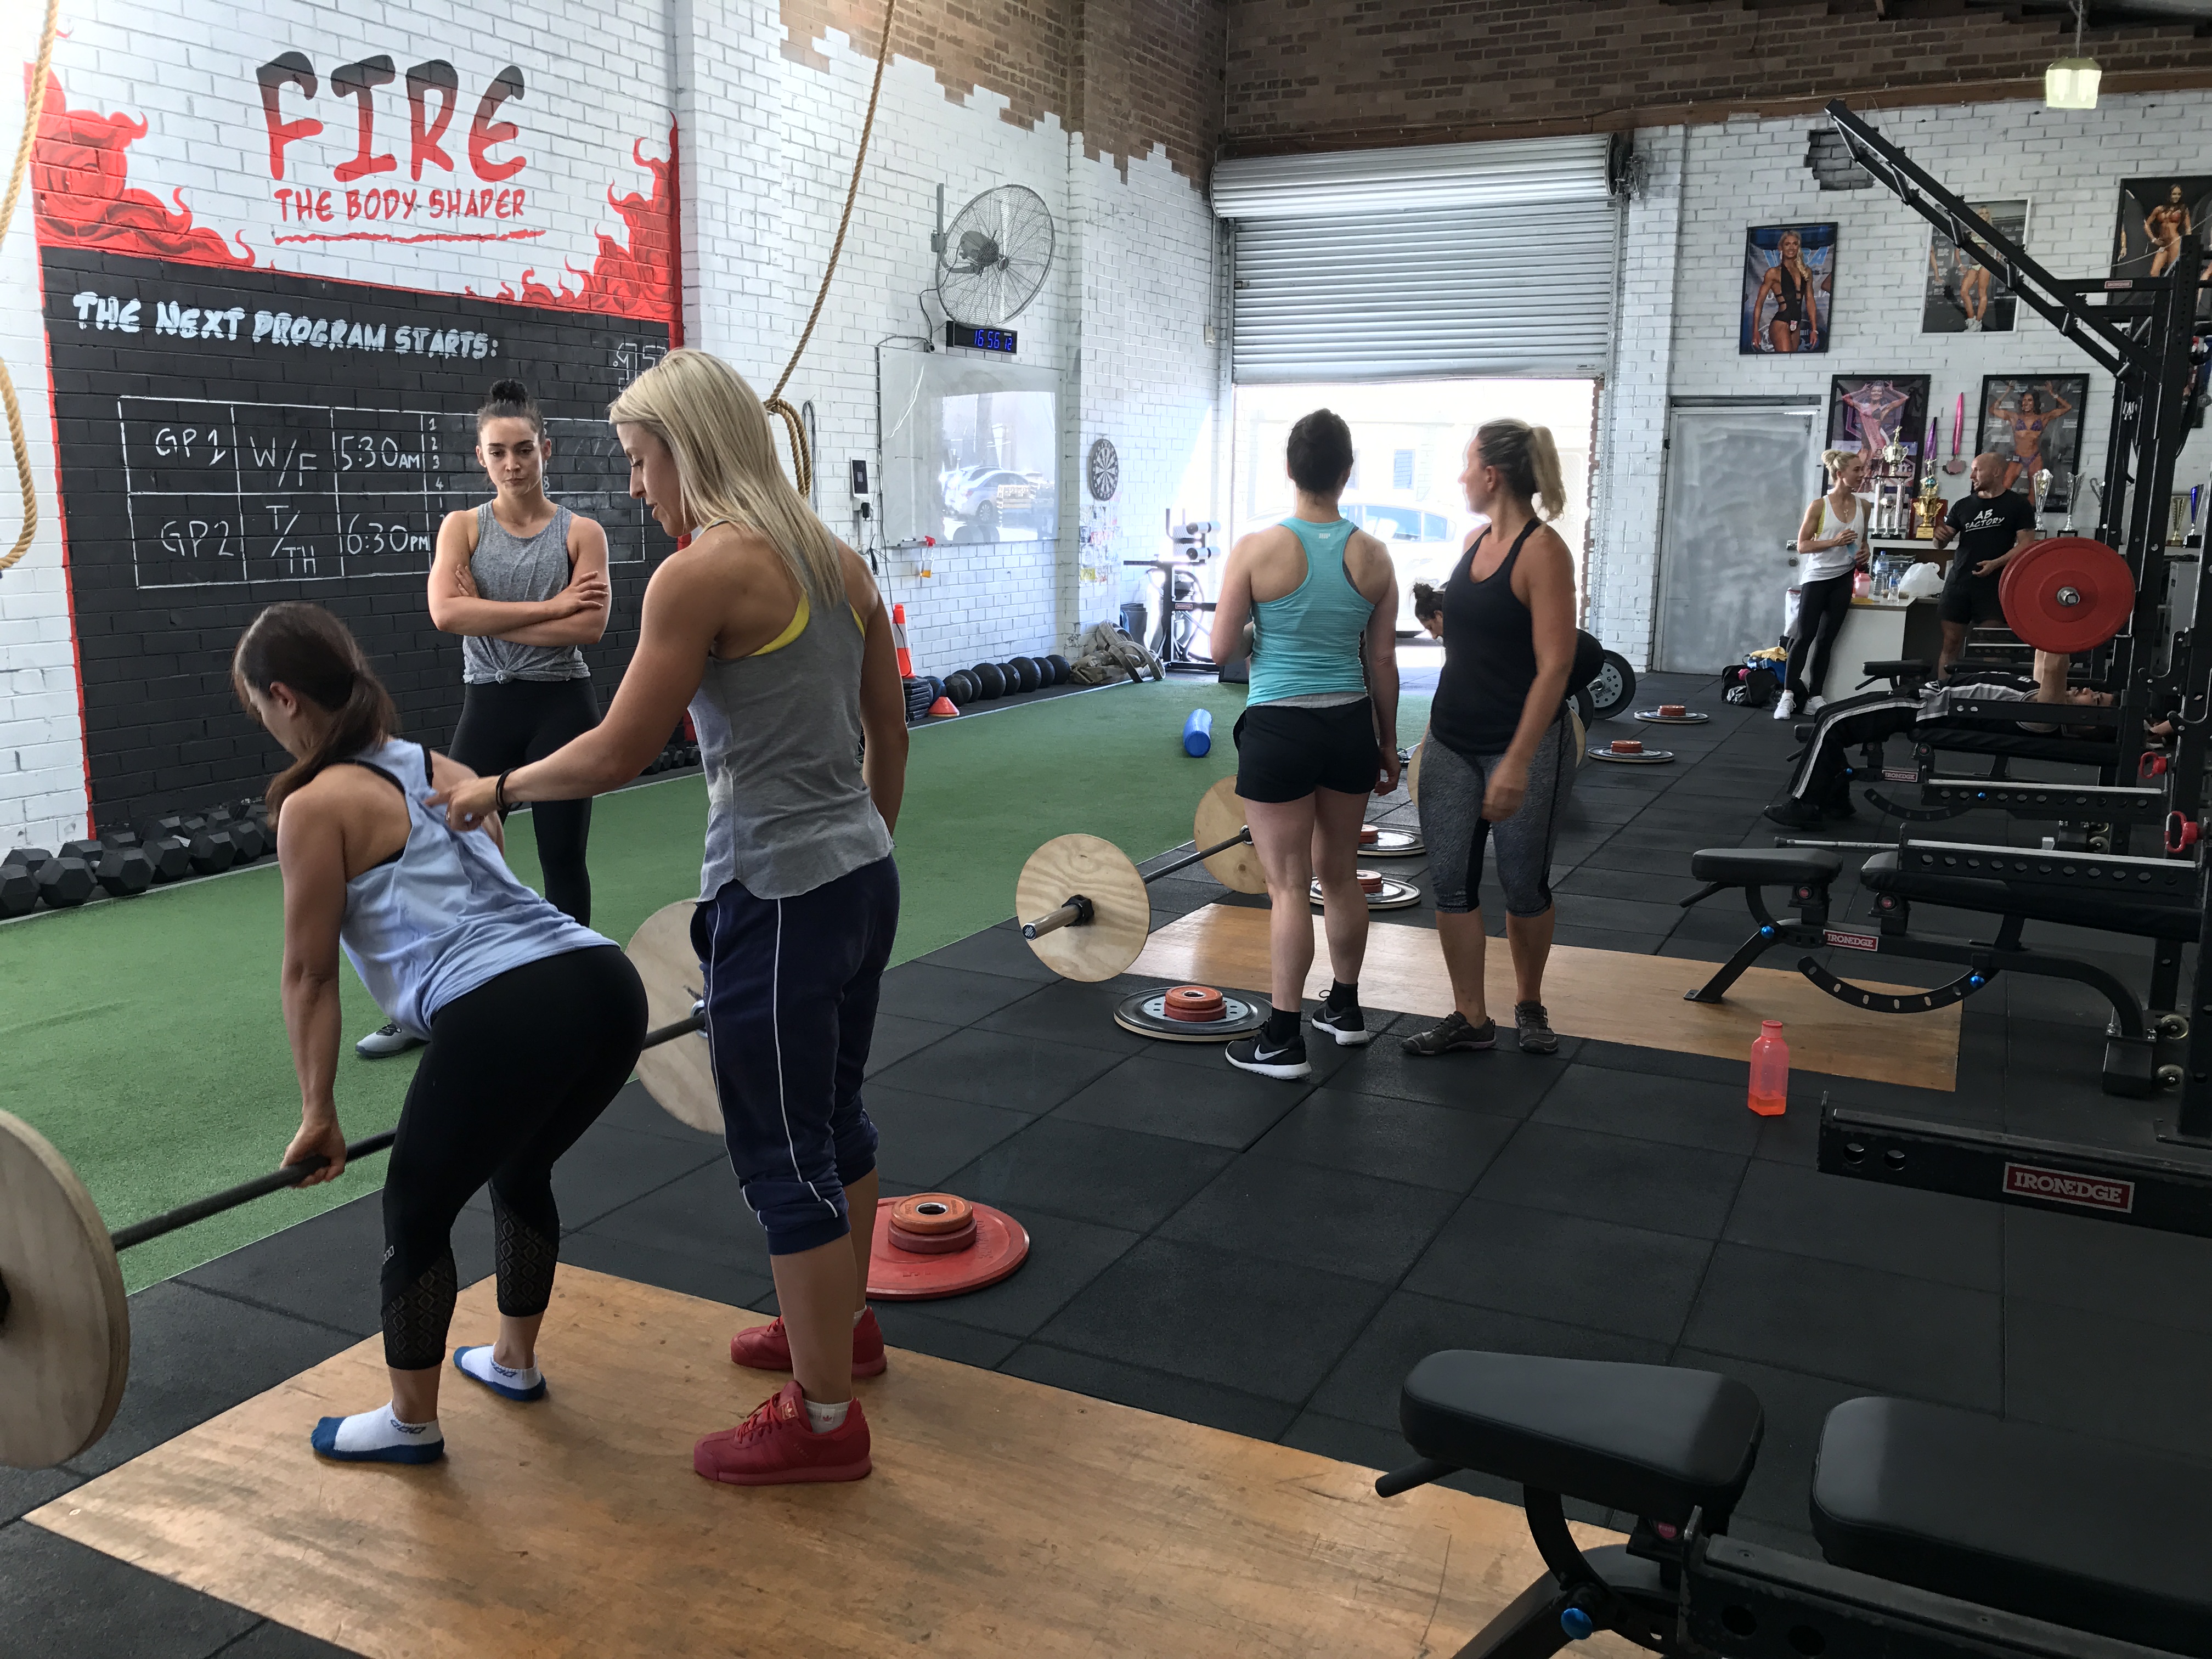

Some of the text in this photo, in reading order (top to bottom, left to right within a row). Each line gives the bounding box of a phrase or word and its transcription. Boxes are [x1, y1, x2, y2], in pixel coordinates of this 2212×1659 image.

[256, 51, 527, 183] FIRE
[274, 188, 526, 222] THE BODY SHAPER
[73, 291, 499, 359] THE NEXT PROGRAM STARTS:
[974, 330, 1012, 351] 16 56 12
[428, 417, 437, 431] 1
[431, 437, 438, 451] 2
[432, 455, 440, 470] 3
[435, 475, 550, 491] 4 8
[1965, 517, 2005, 529] FACTORY
[1973, 509, 1994, 521] AB
[161, 520, 234, 558] GP2
[1827, 934, 1874, 947] IRONEDGE
[2014, 1171, 2123, 1204] IRONEDGE
